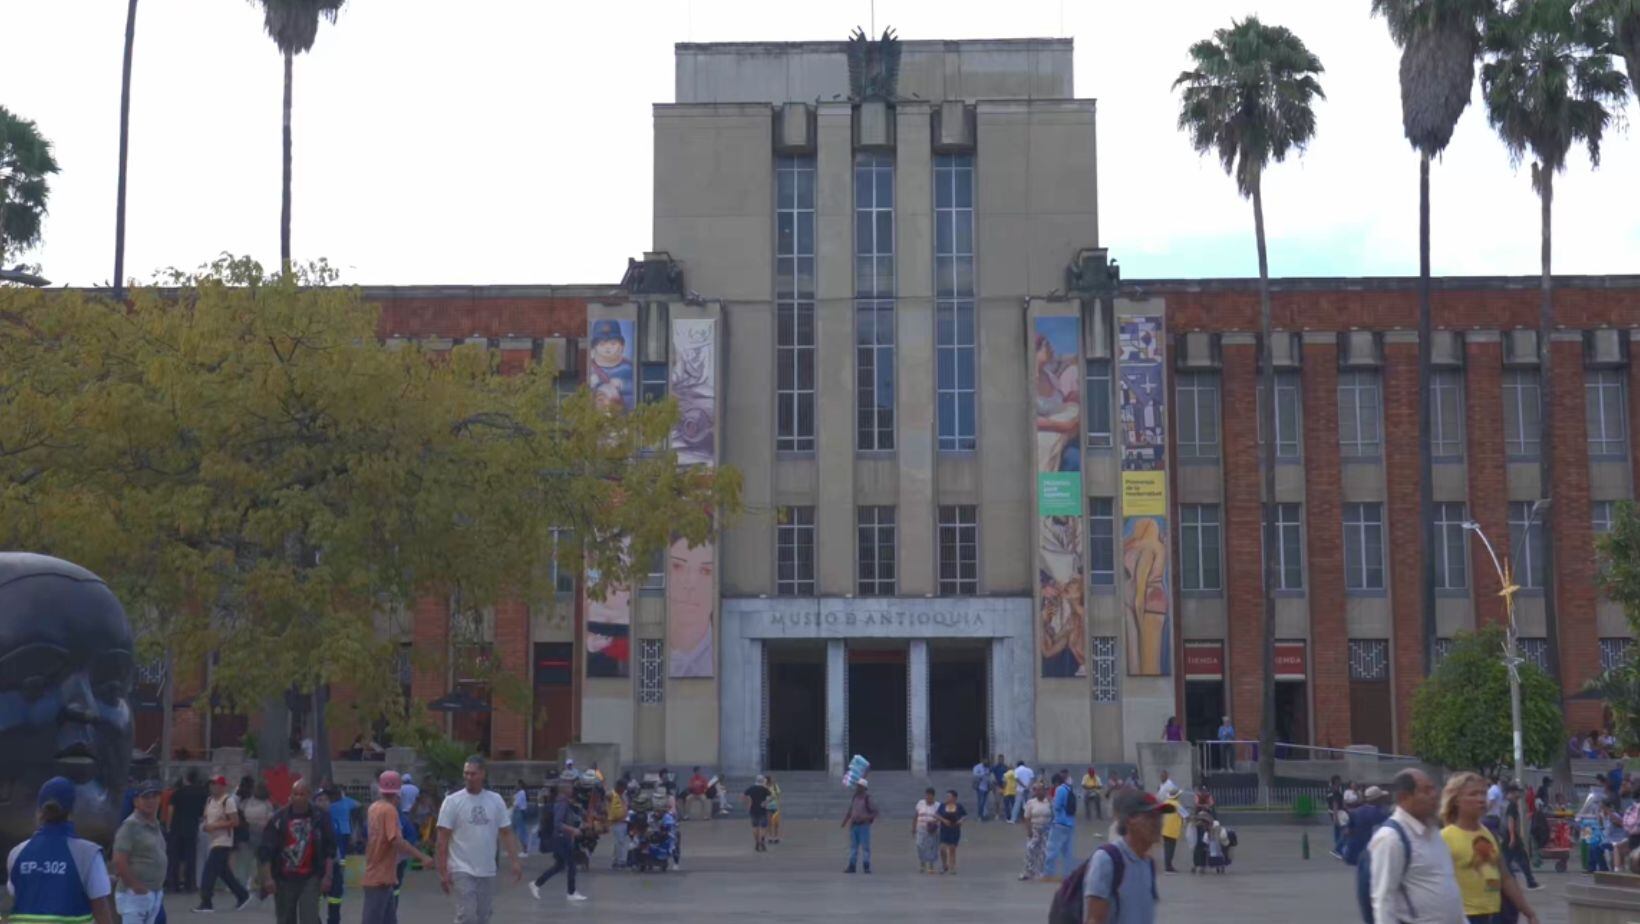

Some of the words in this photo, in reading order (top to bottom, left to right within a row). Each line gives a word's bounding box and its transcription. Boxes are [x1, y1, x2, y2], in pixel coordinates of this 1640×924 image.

[864, 611, 984, 627] ANTIOQUIA
[1187, 655, 1219, 665] TIENDA
[1274, 655, 1302, 665] IENDA
[20, 861, 67, 875] EP-302
